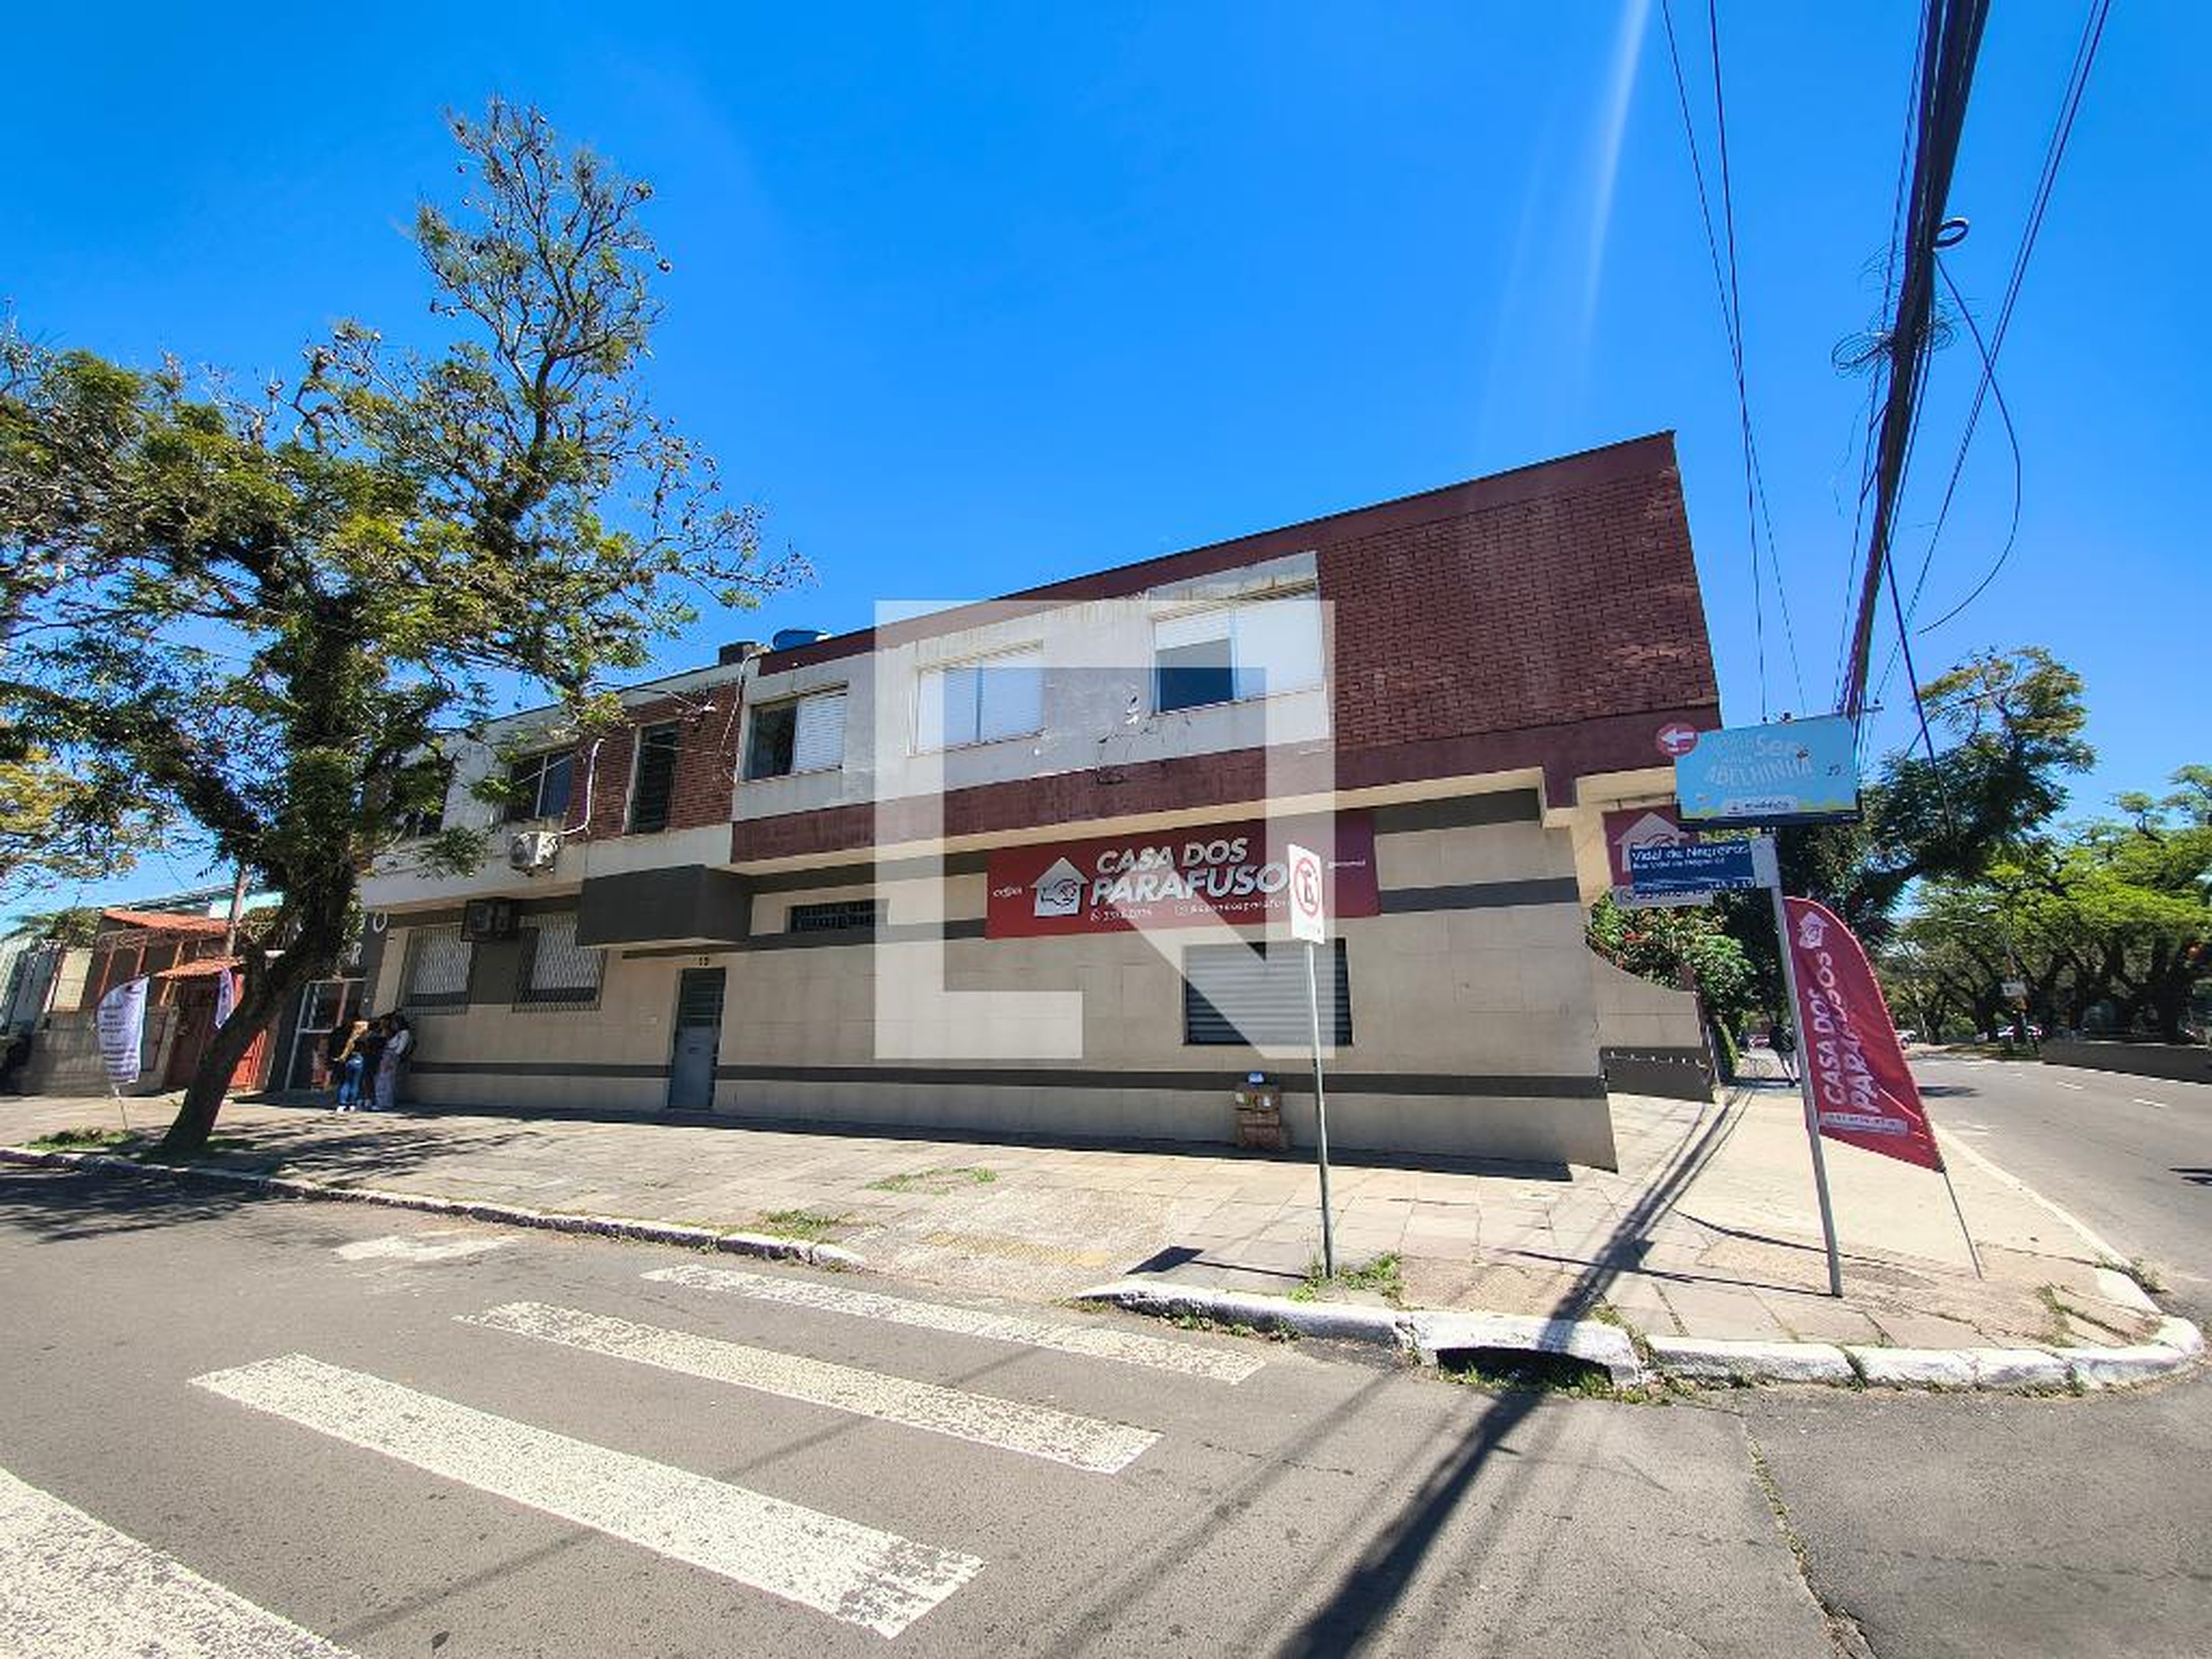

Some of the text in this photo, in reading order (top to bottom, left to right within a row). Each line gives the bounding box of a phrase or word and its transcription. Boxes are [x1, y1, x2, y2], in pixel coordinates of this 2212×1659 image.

[1097, 837, 1248, 873] CASA DOS
[1633, 849, 1662, 861] Vidal
[1090, 862, 1289, 906] PARAFUSO
[1807, 987, 1847, 1105] CASA DOS
